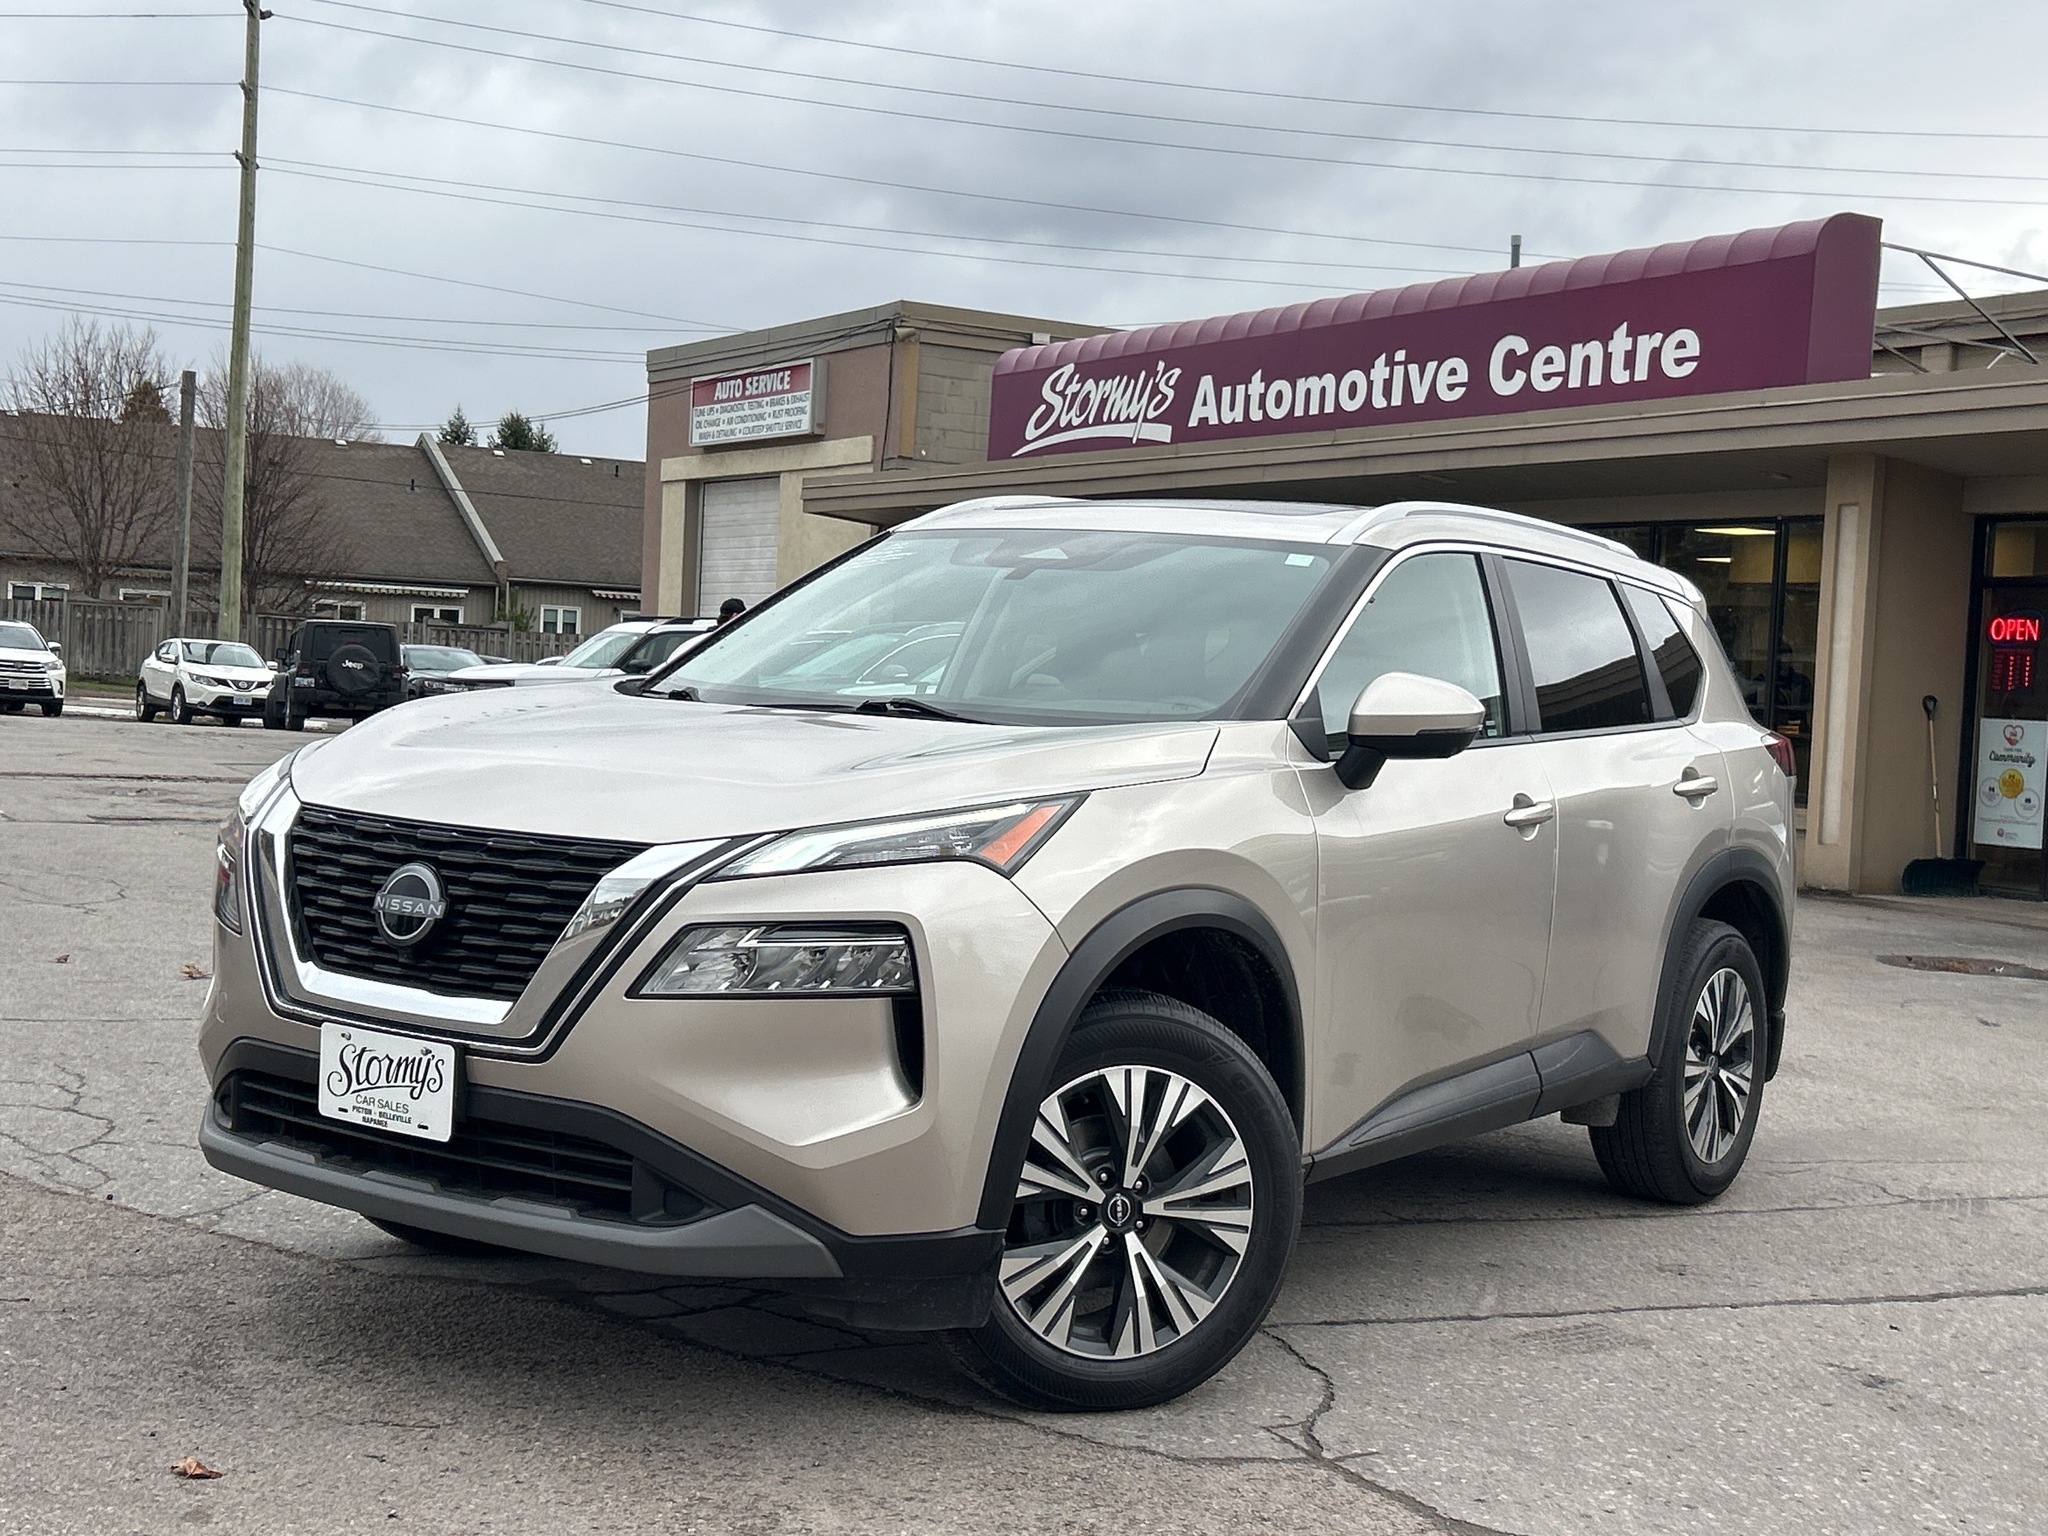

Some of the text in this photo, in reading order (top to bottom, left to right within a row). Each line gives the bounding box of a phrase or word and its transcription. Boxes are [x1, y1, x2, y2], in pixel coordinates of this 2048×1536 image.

[714, 370, 791, 401] AUTO SERVICE
[1024, 321, 1700, 444] Stormy's Automotive Centre
[1991, 617, 2039, 641] OPEN
[341, 659, 364, 670] Jeep
[376, 895, 442, 916] NISSAN
[327, 1043, 445, 1101] Stormy's
[352, 1105, 412, 1124] PICTON BELLEVILLE
[355, 1094, 410, 1114] CAR SALES
